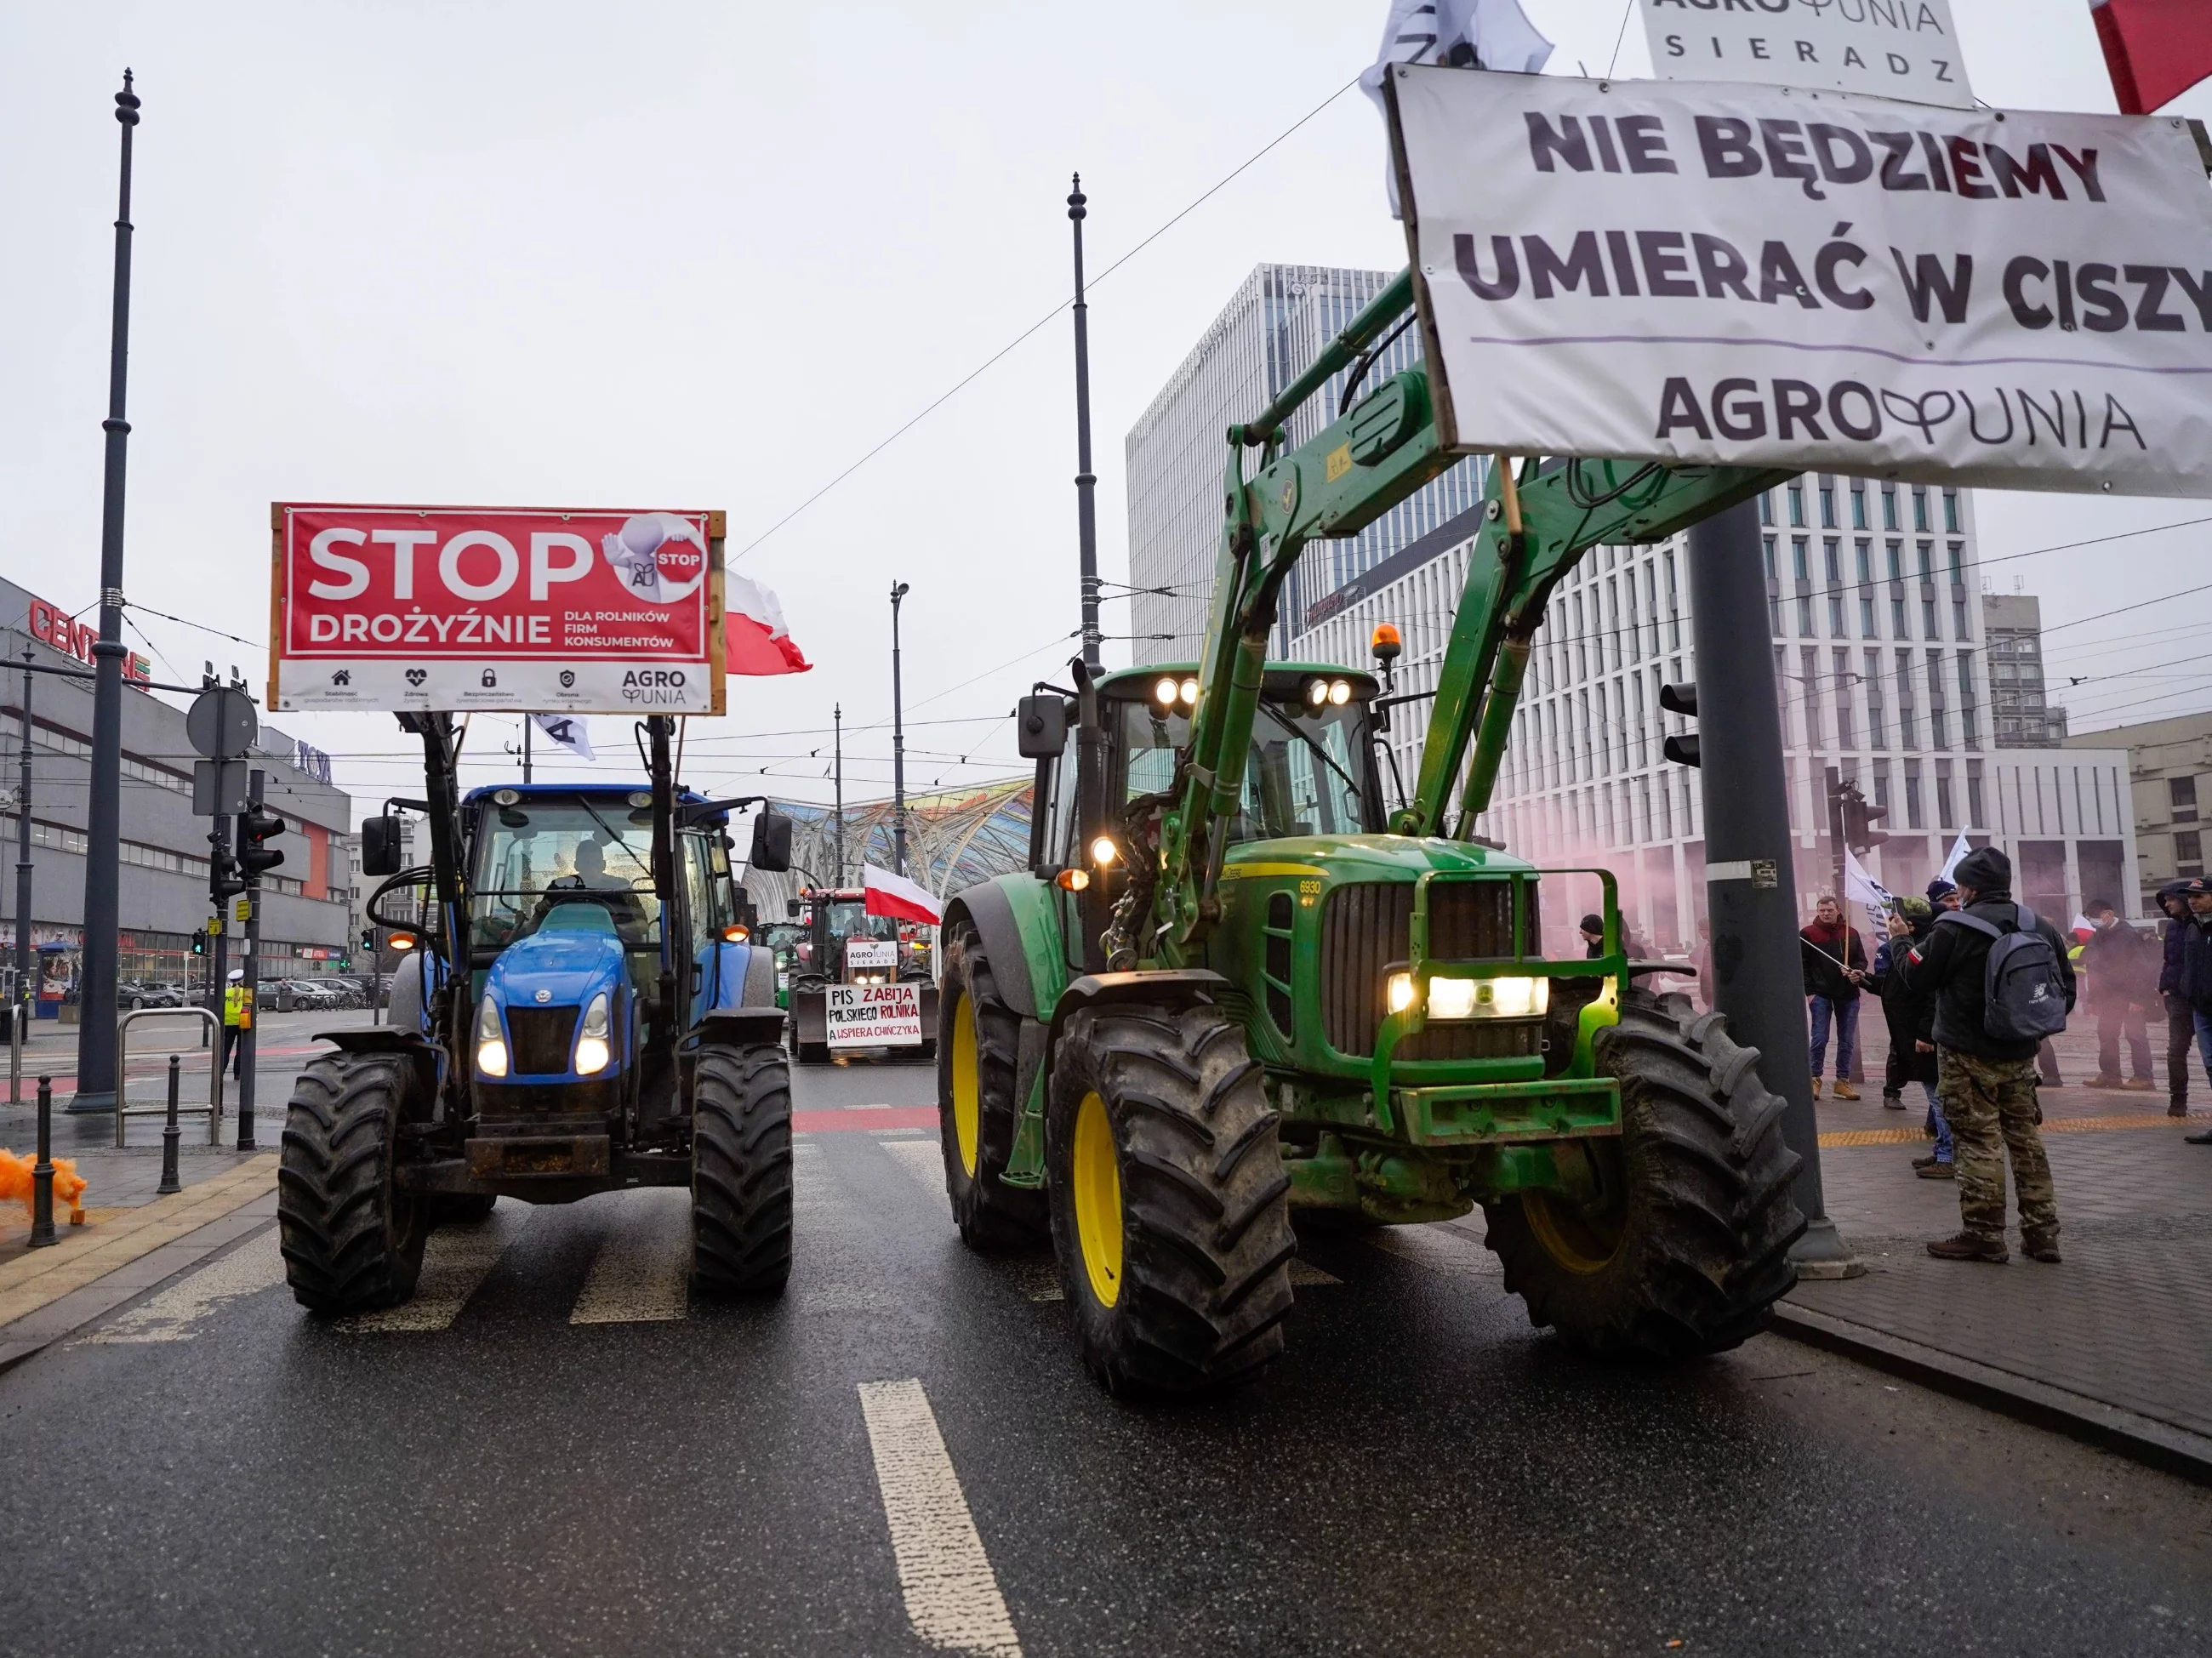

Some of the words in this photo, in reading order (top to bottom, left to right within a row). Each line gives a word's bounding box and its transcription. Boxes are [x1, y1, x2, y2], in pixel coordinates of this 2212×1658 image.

[1664, 34, 1954, 83] SIERADZ
[1523, 111, 1679, 175] NIE
[1693, 114, 2107, 203] BĘDZIEMY
[1452, 220, 1876, 311] UMIERAĆ
[1888, 245, 1973, 324] W
[307, 527, 595, 601] STOP
[658, 553, 700, 567] STOP
[564, 610, 592, 622] DLA
[595, 609, 670, 623] ROLNIKÓW
[310, 606, 552, 644] DROŻYŹNIE
[564, 624, 598, 635] FIRM
[564, 634, 675, 648] KONSUMENTÓW
[623, 669, 686, 687] AGRO
[641, 688, 687, 704] UNIA
[1299, 880, 1321, 894] 6930
[831, 989, 854, 1006] PIS
[863, 988, 914, 1004] ZABIJA
[829, 1006, 877, 1023] POLSKIEGO
[829, 1029, 837, 1040] A
[837, 1027, 873, 1039] WSPIERA
[875, 1024, 920, 1036] CHIŃCZYKA
